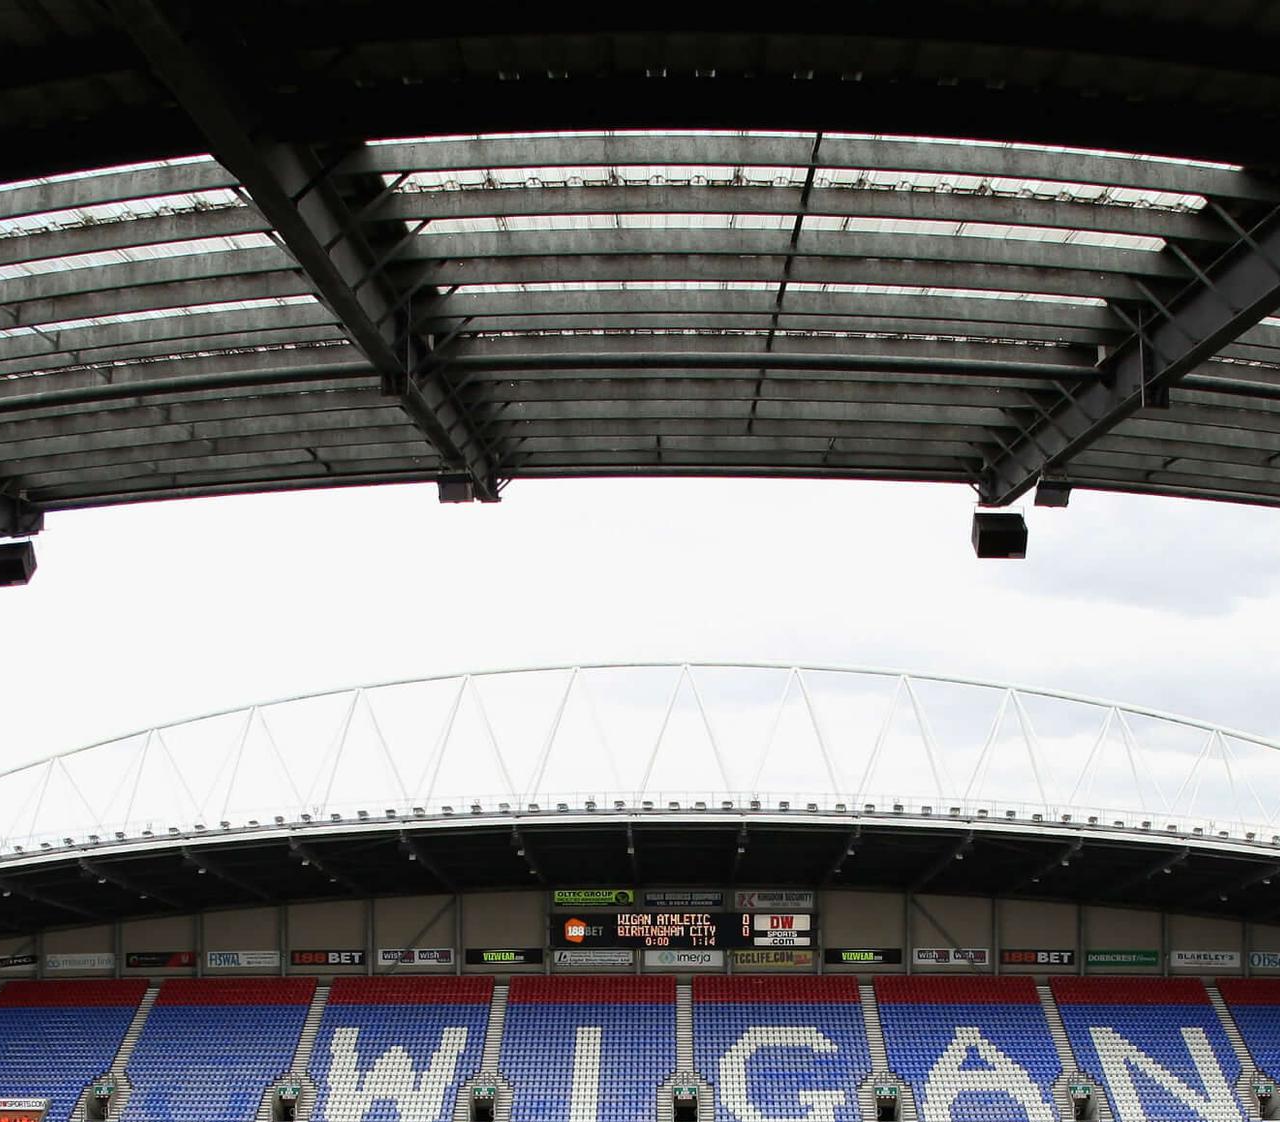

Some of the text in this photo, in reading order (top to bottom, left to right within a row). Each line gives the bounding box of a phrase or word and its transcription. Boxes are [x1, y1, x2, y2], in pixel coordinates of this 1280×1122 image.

[618, 914, 651, 925] WIGAN
[657, 914, 710, 925] ATHLETIC
[770, 916, 795, 929] DW
[618, 926, 684, 937] BIRMINGHAM
[690, 926, 716, 937] CITY
[677, 950, 711, 964] imerja
